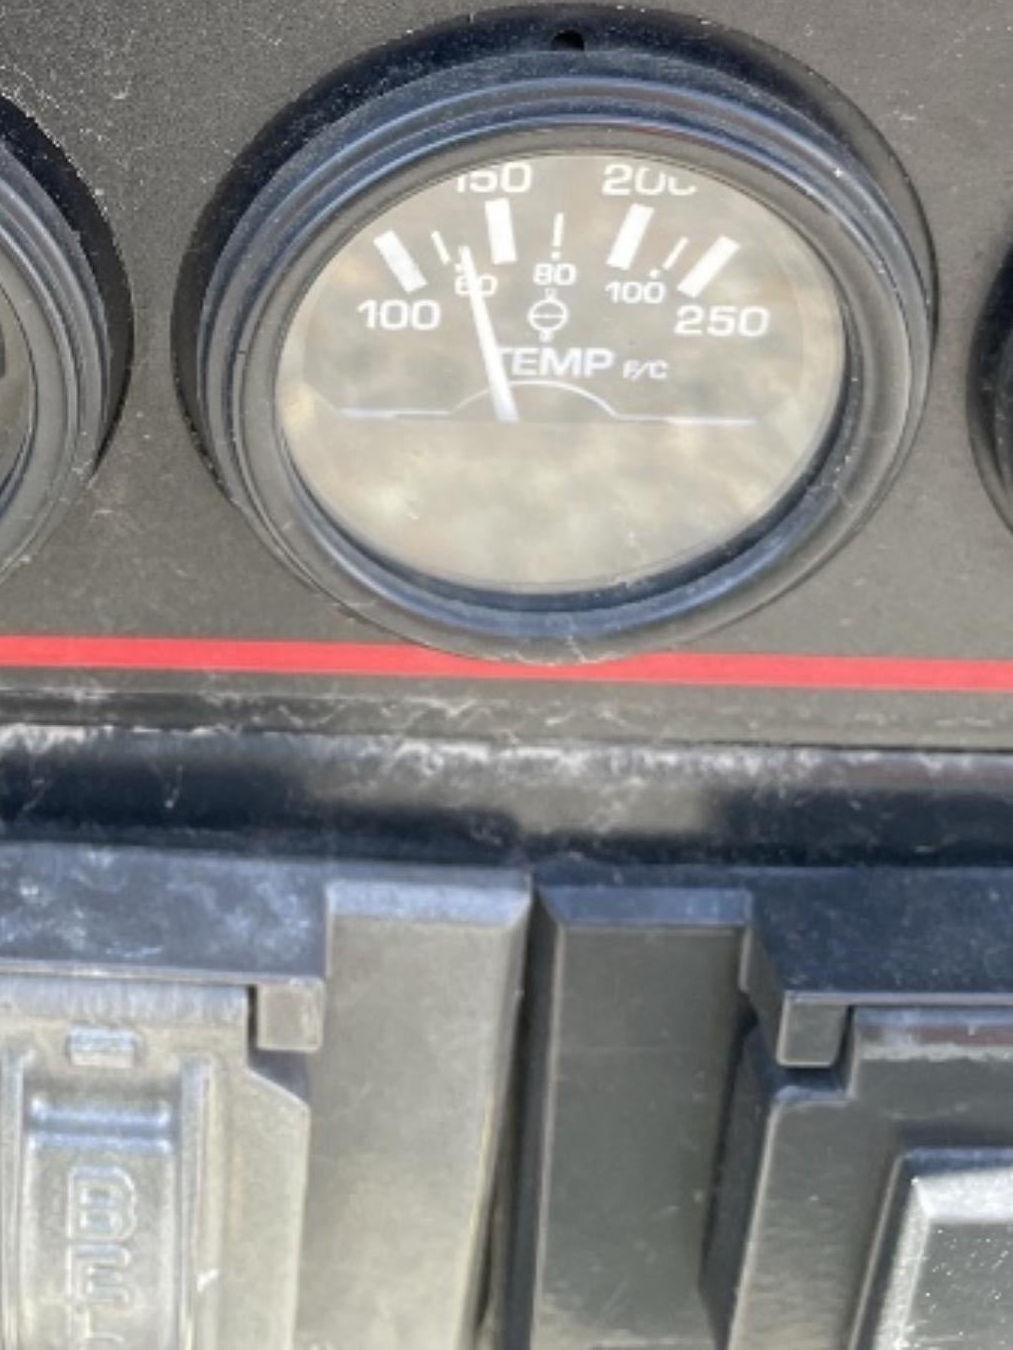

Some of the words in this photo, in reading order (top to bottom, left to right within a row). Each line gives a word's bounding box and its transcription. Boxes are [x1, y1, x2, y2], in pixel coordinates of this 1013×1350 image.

[532, 262, 578, 287] 80
[604, 280, 667, 305] 100
[356, 298, 441, 332] 100
[674, 305, 770, 338] 250
